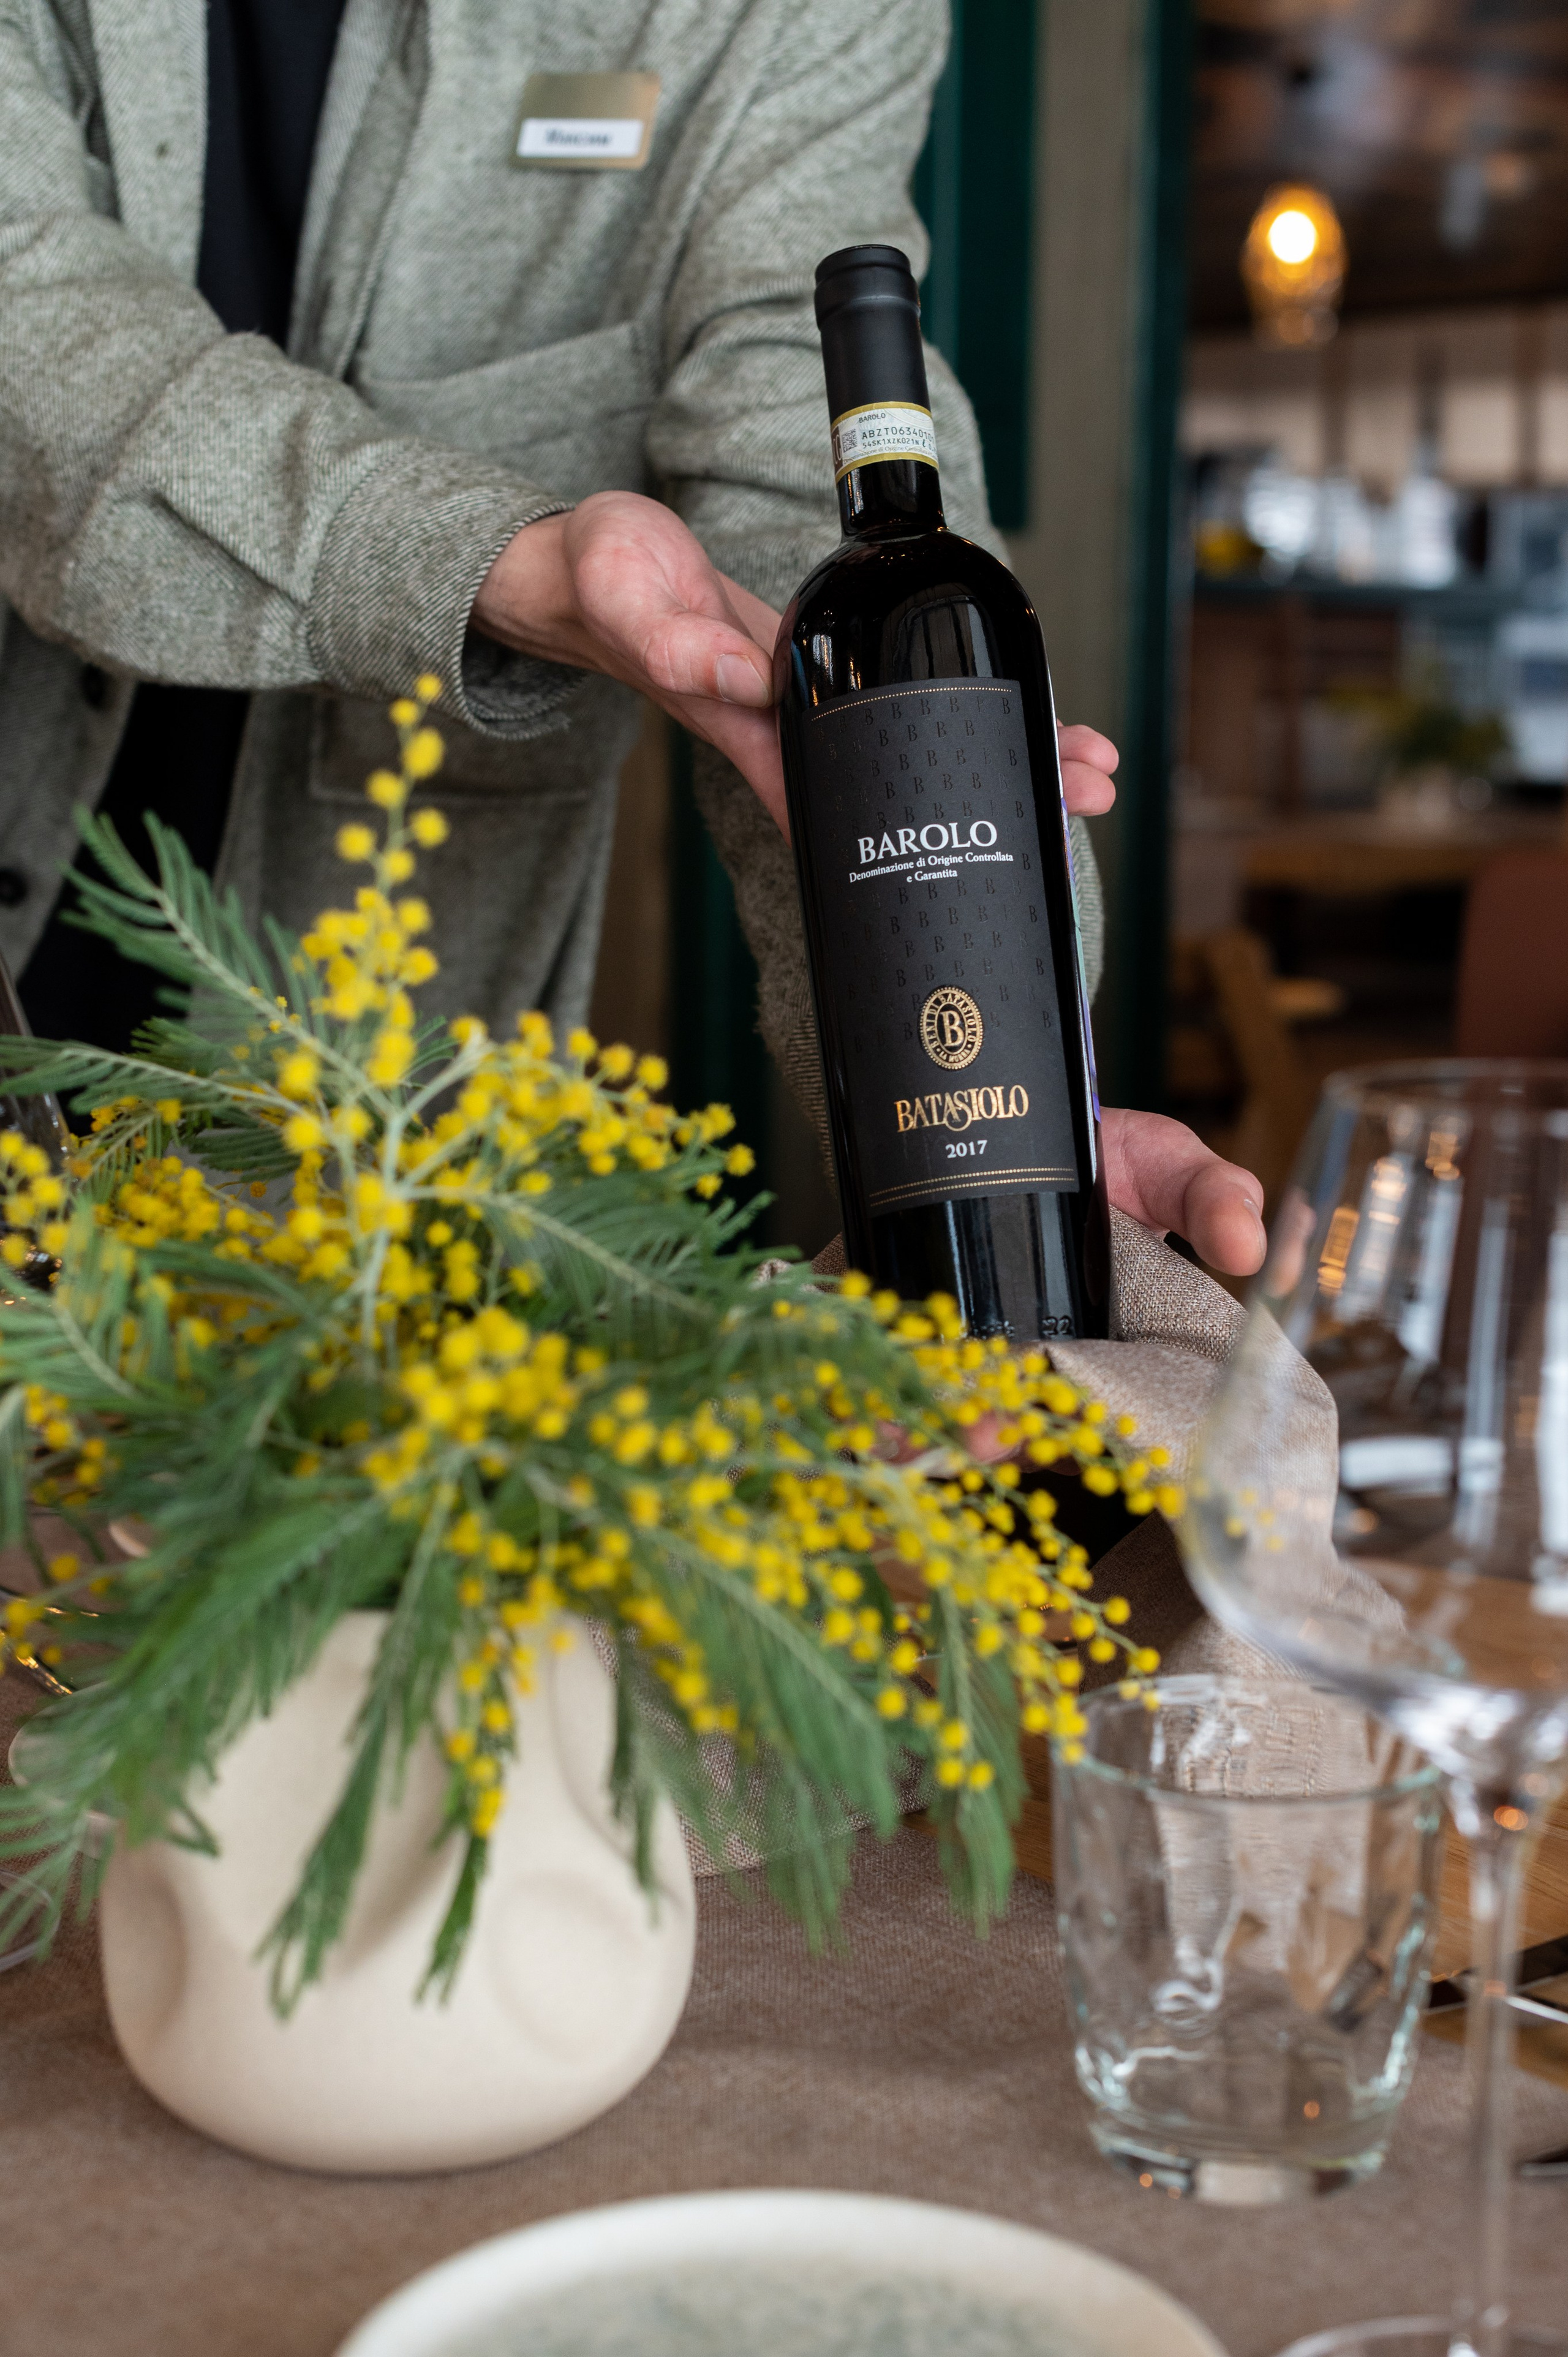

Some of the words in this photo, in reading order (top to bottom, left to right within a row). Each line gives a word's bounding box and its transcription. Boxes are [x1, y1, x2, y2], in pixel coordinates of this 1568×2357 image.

[859, 412, 886, 423] BAROLO
[865, 708, 873, 725] B
[891, 703, 902, 719] B
[920, 698, 930, 715] B
[949, 696, 959, 713] B
[1002, 697, 1010, 714] B
[878, 729, 888, 747] B
[907, 725, 918, 741] B
[936, 721, 946, 738] B
[965, 719, 974, 736] B
[870, 760, 880, 777] B
[899, 753, 910, 771] B
[927, 750, 937, 767] B
[956, 749, 966, 765] B
[1008, 749, 1016, 766] B
[885, 782, 895, 799] B
[913, 777, 924, 794] B
[943, 774, 952, 790] B
[971, 772, 981, 789] B
[878, 812, 886, 829] B
[905, 806, 914, 824] B
[933, 802, 944, 819] B
[962, 801, 972, 818] B
[1015, 801, 1023, 818] B
[858, 821, 997, 864] BAROLO
[849, 861, 914, 883] Denominazione
[916, 858, 926, 867] di
[927, 854, 963, 866] Origine
[965, 851, 1014, 862] Controllata
[914, 869, 958, 881] Garantita
[1022, 853, 1030, 870] B
[899, 887, 908, 905] B
[928, 882, 938, 900] B
[957, 879, 967, 896] B
[986, 877, 995, 895] B
[890, 916, 900, 934] B
[919, 911, 929, 928] B
[948, 907, 959, 925] B
[978, 905, 988, 922] B
[1029, 905, 1037, 922] B
[905, 940, 915, 957] B
[934, 935, 944, 952] B
[963, 932, 973, 950] B
[992, 930, 1001, 948] B
[896, 970, 905, 987] B
[923, 964, 934, 981] B
[954, 960, 964, 978] B
[983, 957, 992, 975] B
[1036, 957, 1044, 975] B
[1000, 984, 1008, 1001] B
[937, 992, 977, 1042] BATASIOLO
[939, 1010, 964, 1047] B
[1042, 1011, 1050, 1028] B
[894, 1085, 1029, 1133] BATASIOLO
[945, 1139, 987, 1158] 2017
